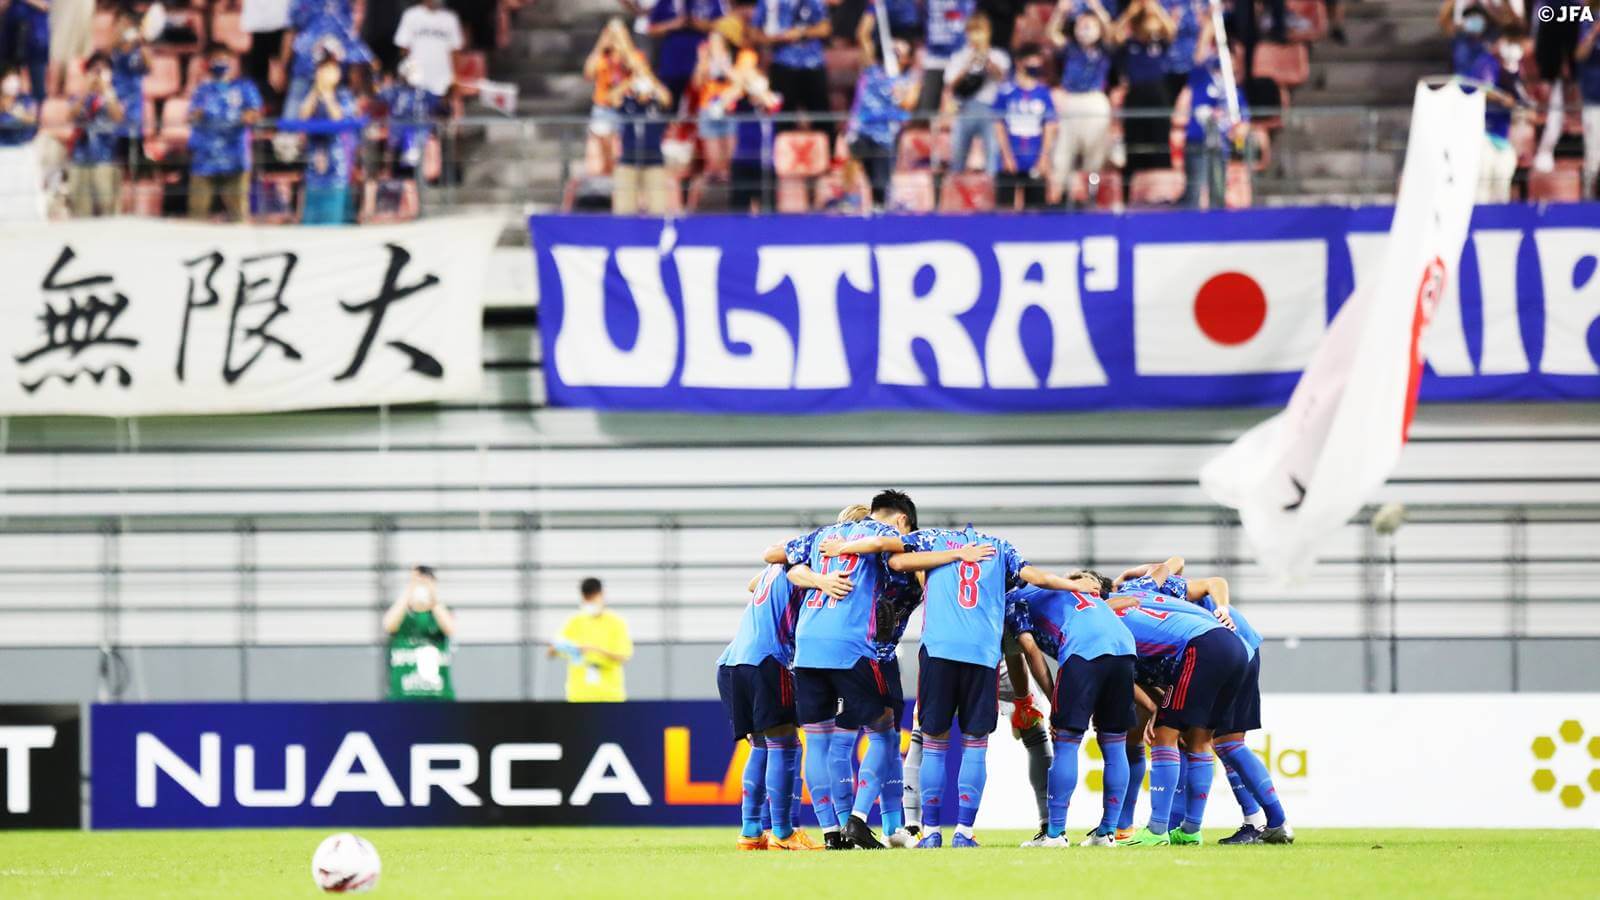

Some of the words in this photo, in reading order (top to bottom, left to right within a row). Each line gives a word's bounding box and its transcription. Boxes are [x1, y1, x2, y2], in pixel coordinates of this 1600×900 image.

[15, 242, 445, 394] 無限大
[957, 560, 981, 609] 8
